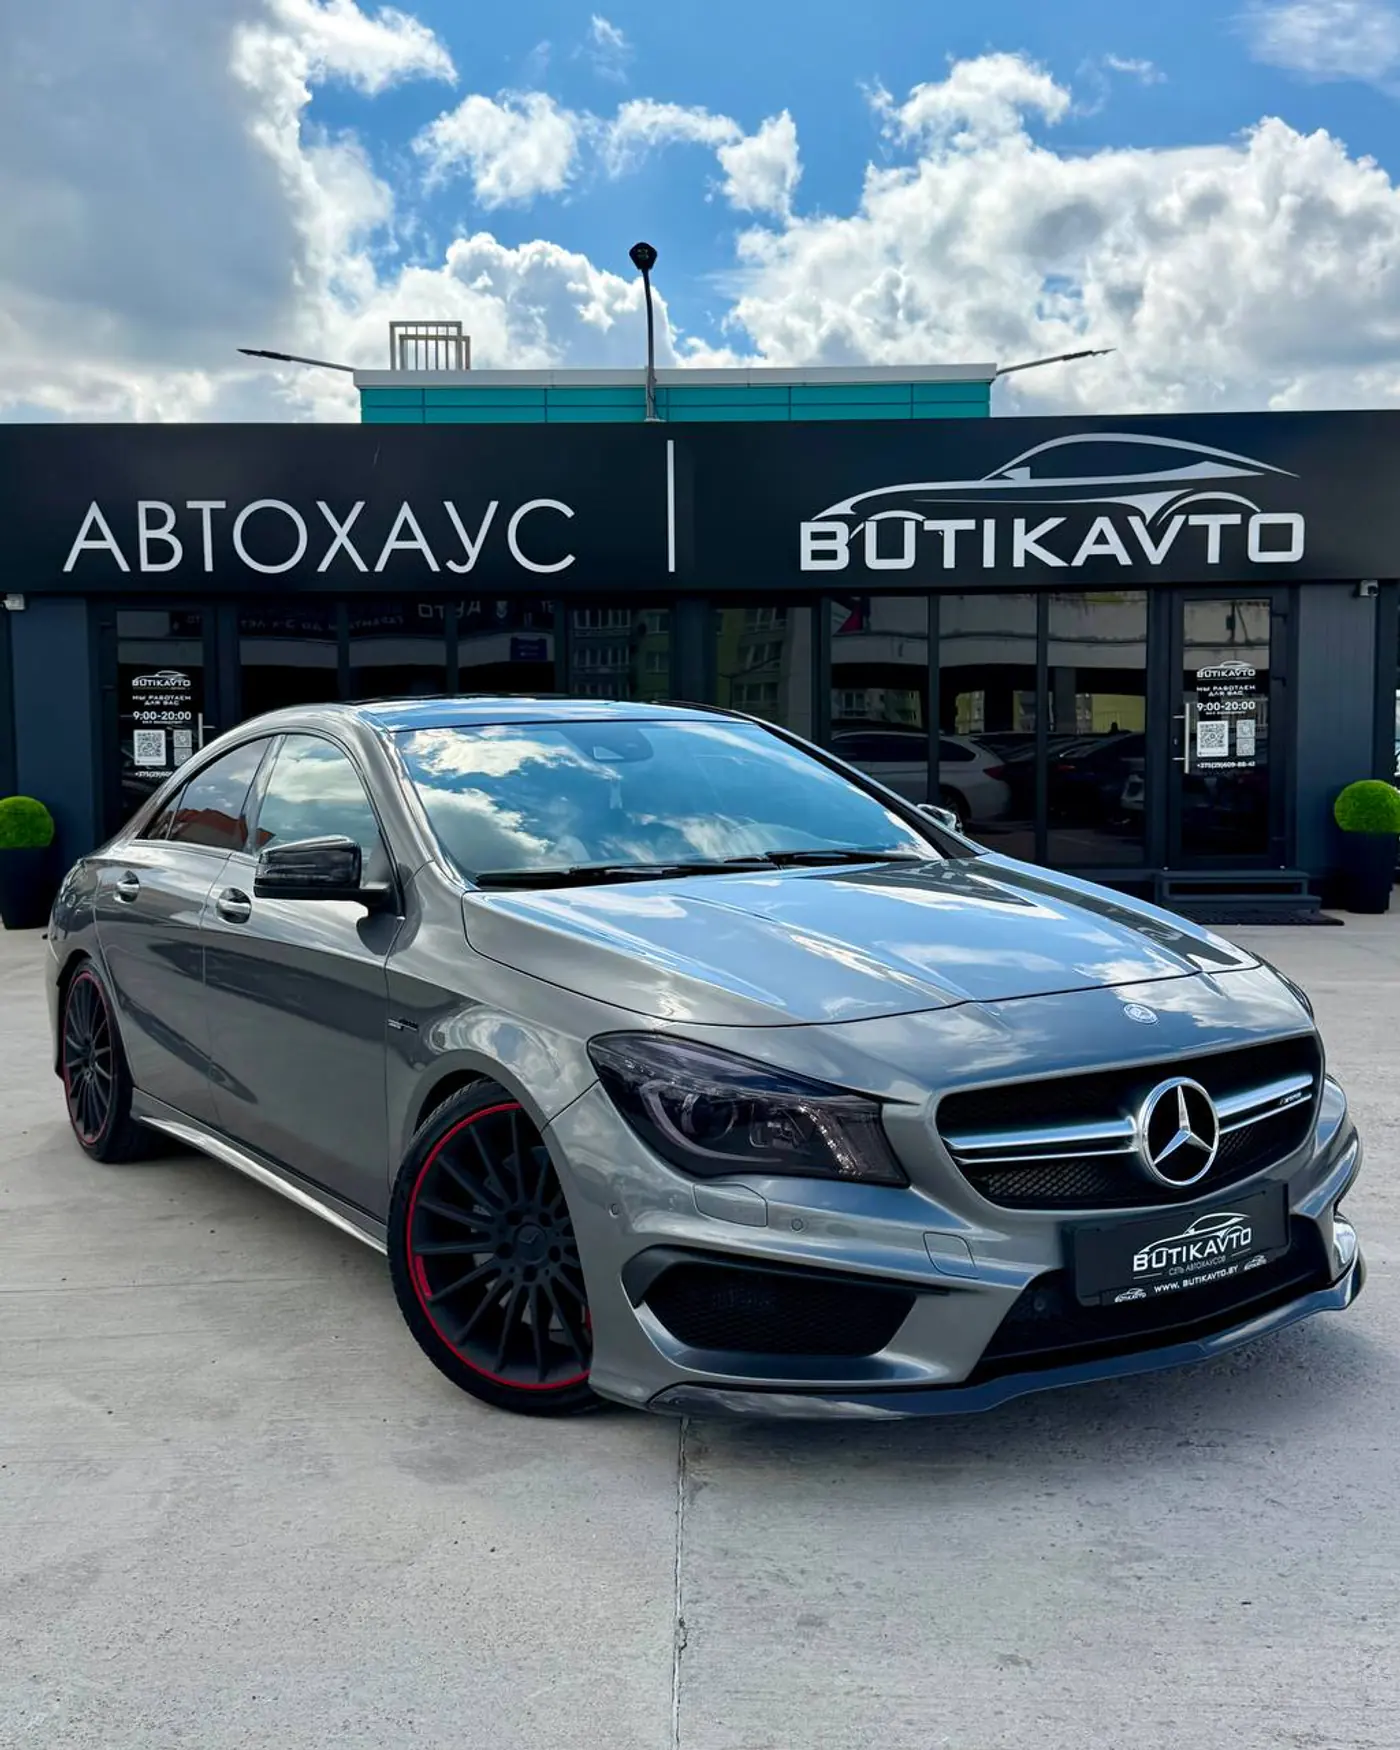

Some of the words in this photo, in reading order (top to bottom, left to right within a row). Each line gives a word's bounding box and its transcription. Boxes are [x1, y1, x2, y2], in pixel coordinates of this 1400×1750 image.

[63, 499, 576, 574] АВТОХАУС
[800, 511, 1305, 571] BUTIKAVTO
[132, 679, 191, 687] BUTIKAVTO
[1197, 669, 1256, 678] BUTIKAVTO
[132, 710, 192, 721] 9:00-20:00
[1197, 701, 1256, 712] 9:00-20:00
[1132, 1227, 1252, 1272] BUTIKAVTO
[1153, 1281, 1180, 1293] WWW.
[1182, 1264, 1239, 1288] BUTIKAVTO.BY
